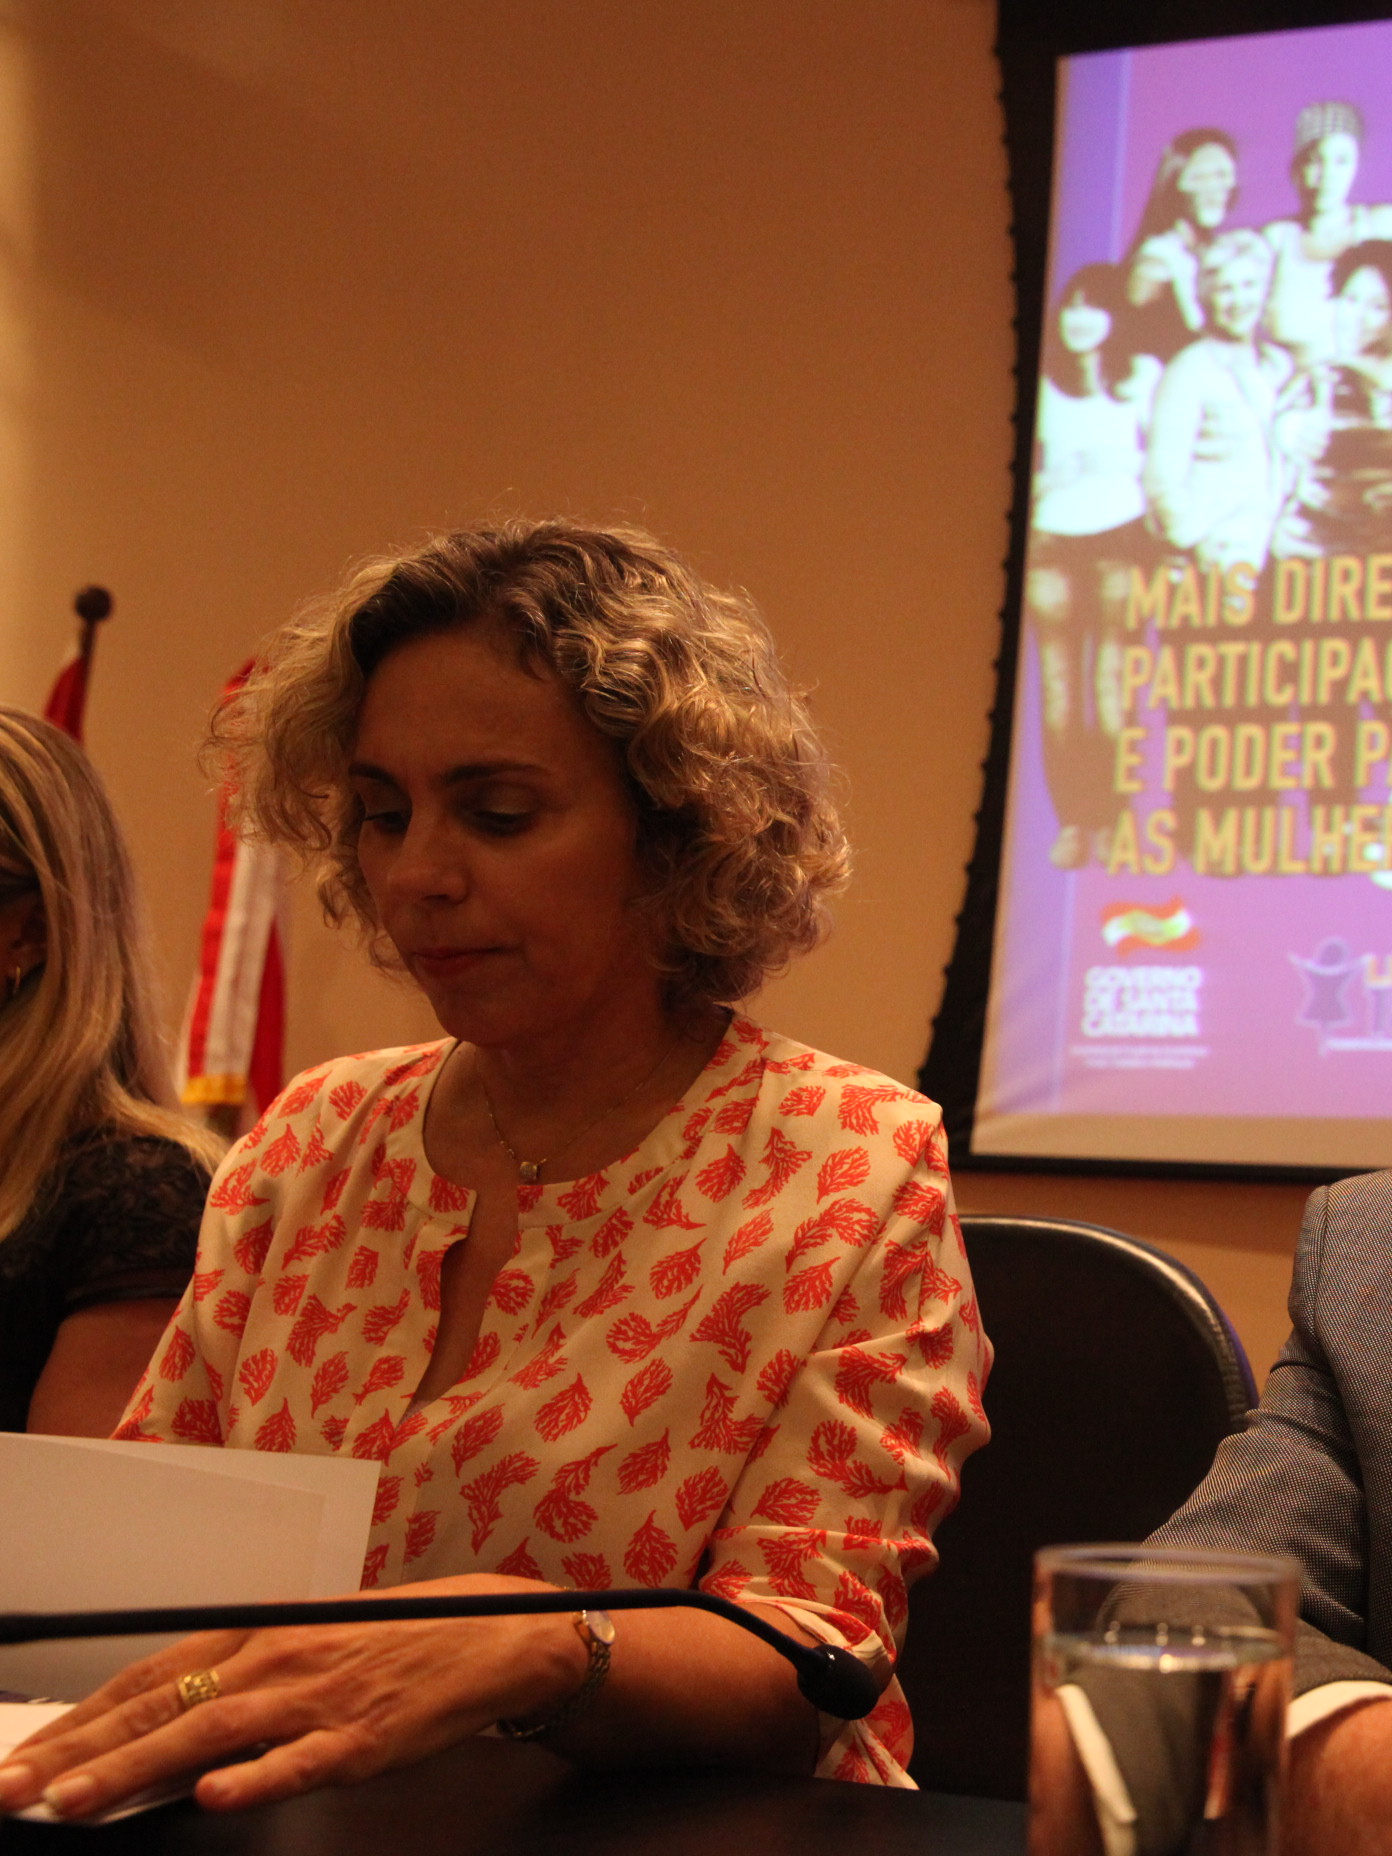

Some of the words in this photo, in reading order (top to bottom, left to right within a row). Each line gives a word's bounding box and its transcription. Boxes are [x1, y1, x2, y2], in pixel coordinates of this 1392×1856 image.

[1127, 560, 1258, 632] MAIS
[1114, 726, 1147, 794] E
[1162, 720, 1336, 793] PODER
[1107, 808, 1178, 877] AS
